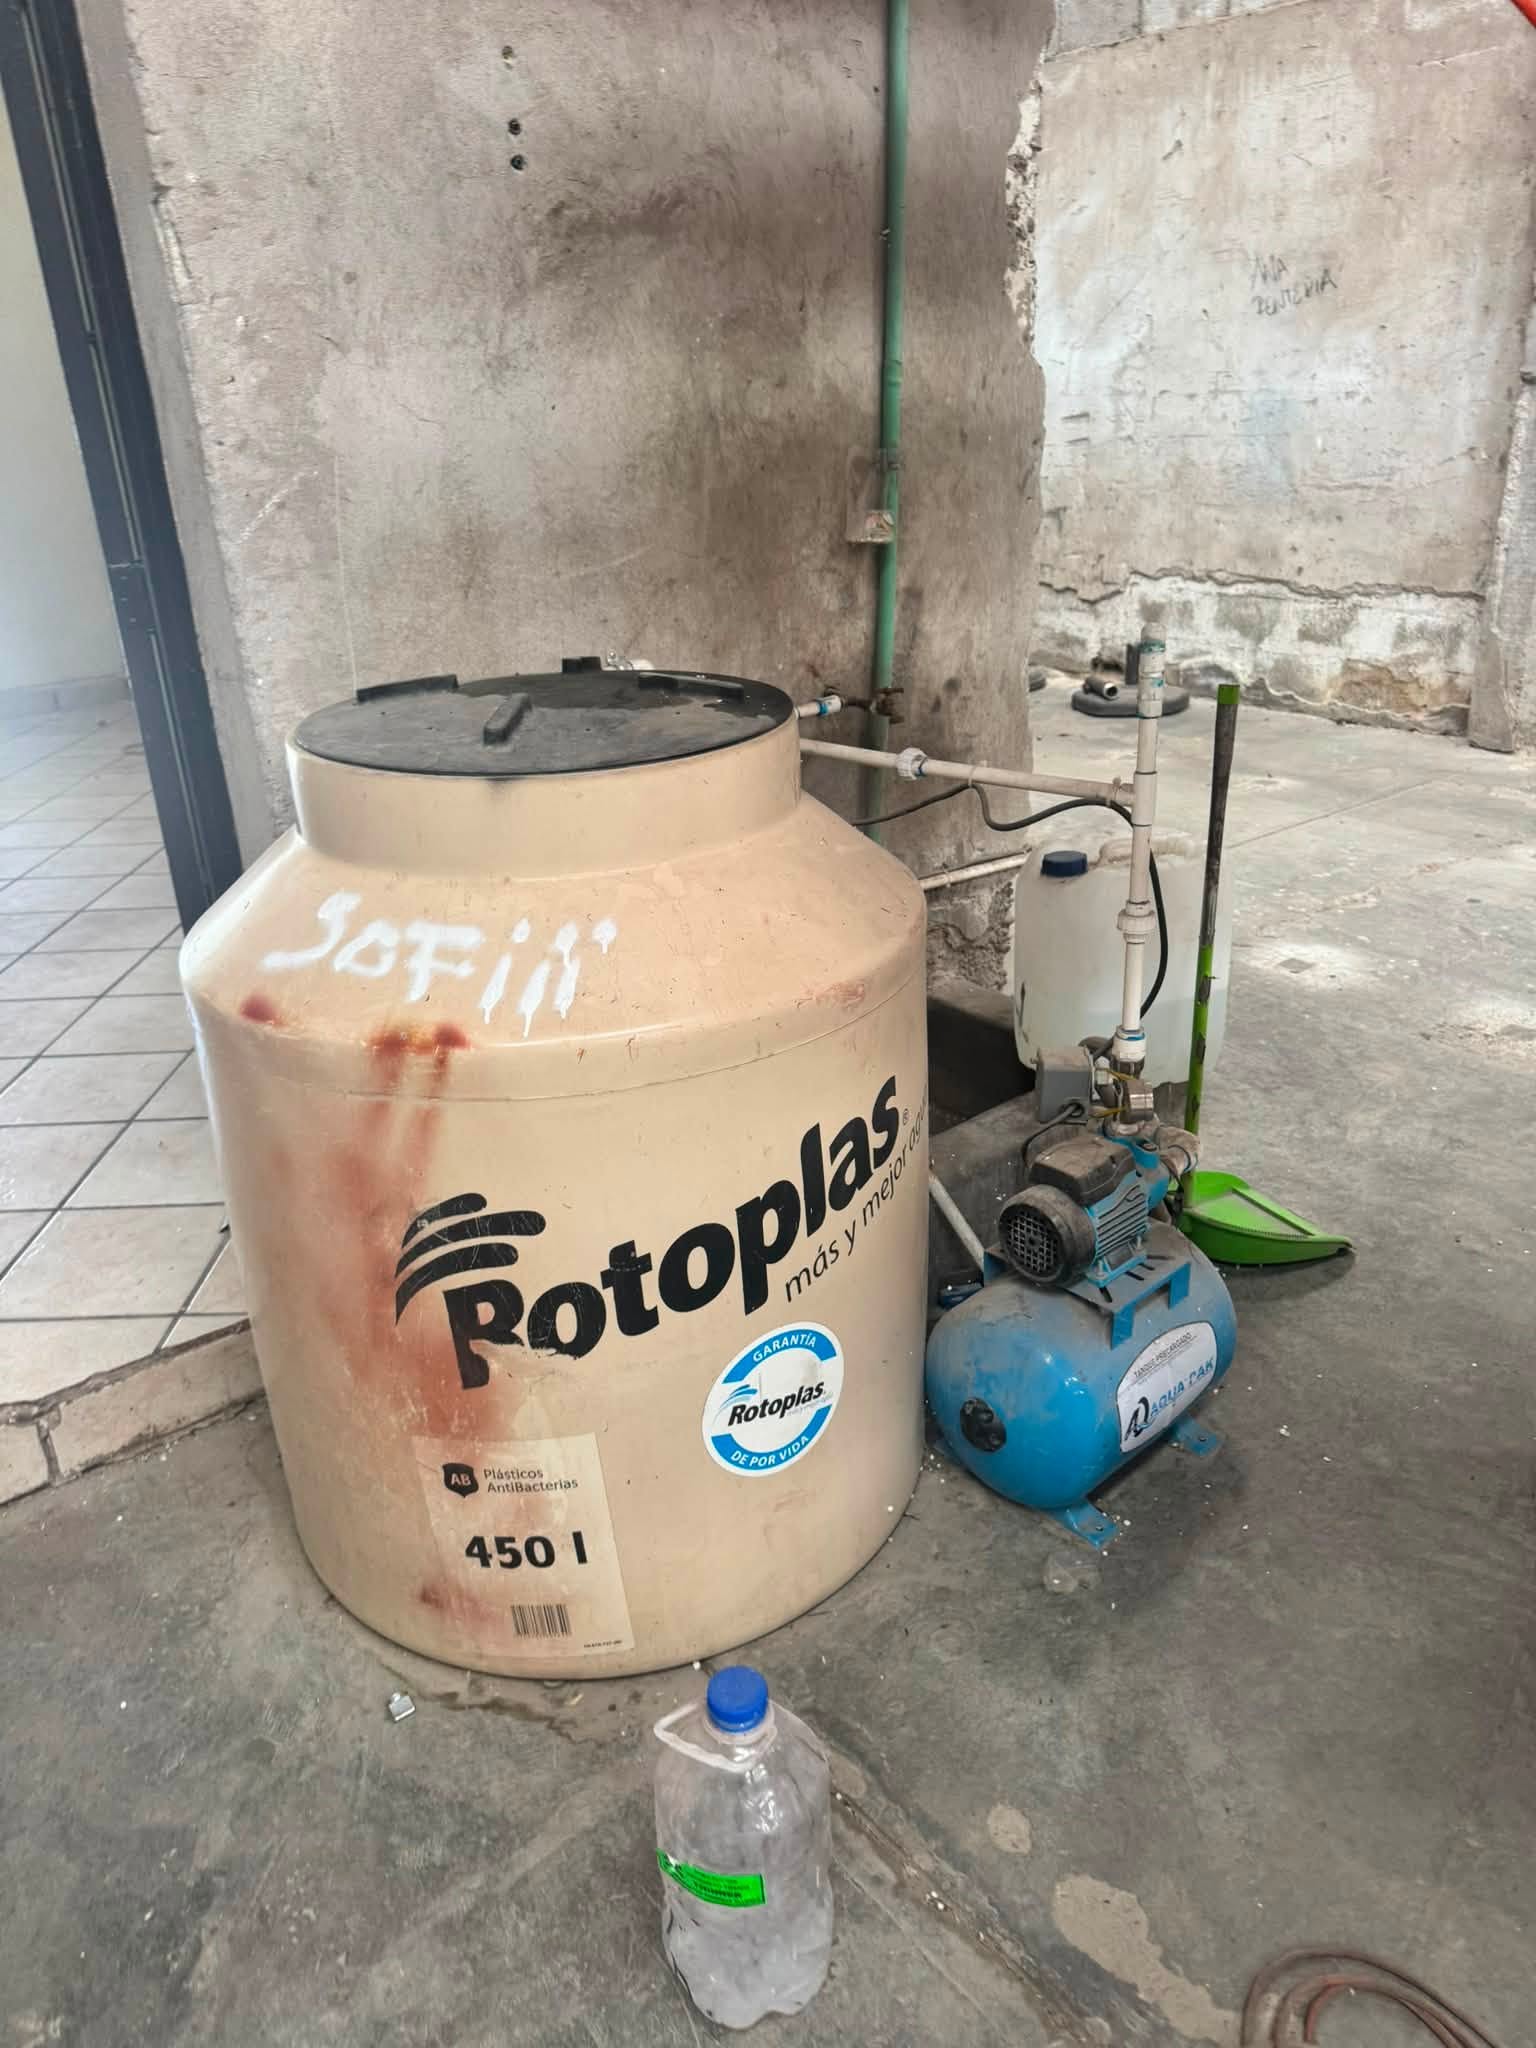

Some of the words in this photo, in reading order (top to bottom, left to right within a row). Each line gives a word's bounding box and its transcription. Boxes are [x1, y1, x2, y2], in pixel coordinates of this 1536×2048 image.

[443, 1075, 900, 1390] Rotoplas
[785, 1239, 840, 1303] más
[844, 1220, 856, 1256] y
[862, 1149, 907, 1226] mejor
[753, 1332, 817, 1363] GARANTÍA
[728, 1381, 825, 1427] Rotoplas
[1150, 1381, 1185, 1417] AQUA
[731, 1450, 749, 1466] DE
[749, 1455, 776, 1467] POR
[779, 1435, 810, 1461] VIDA
[450, 1472, 472, 1486] AB
[483, 1467, 544, 1480] Plásticos
[487, 1478, 579, 1494] AntiBacterias
[465, 1535, 556, 1569] 450
